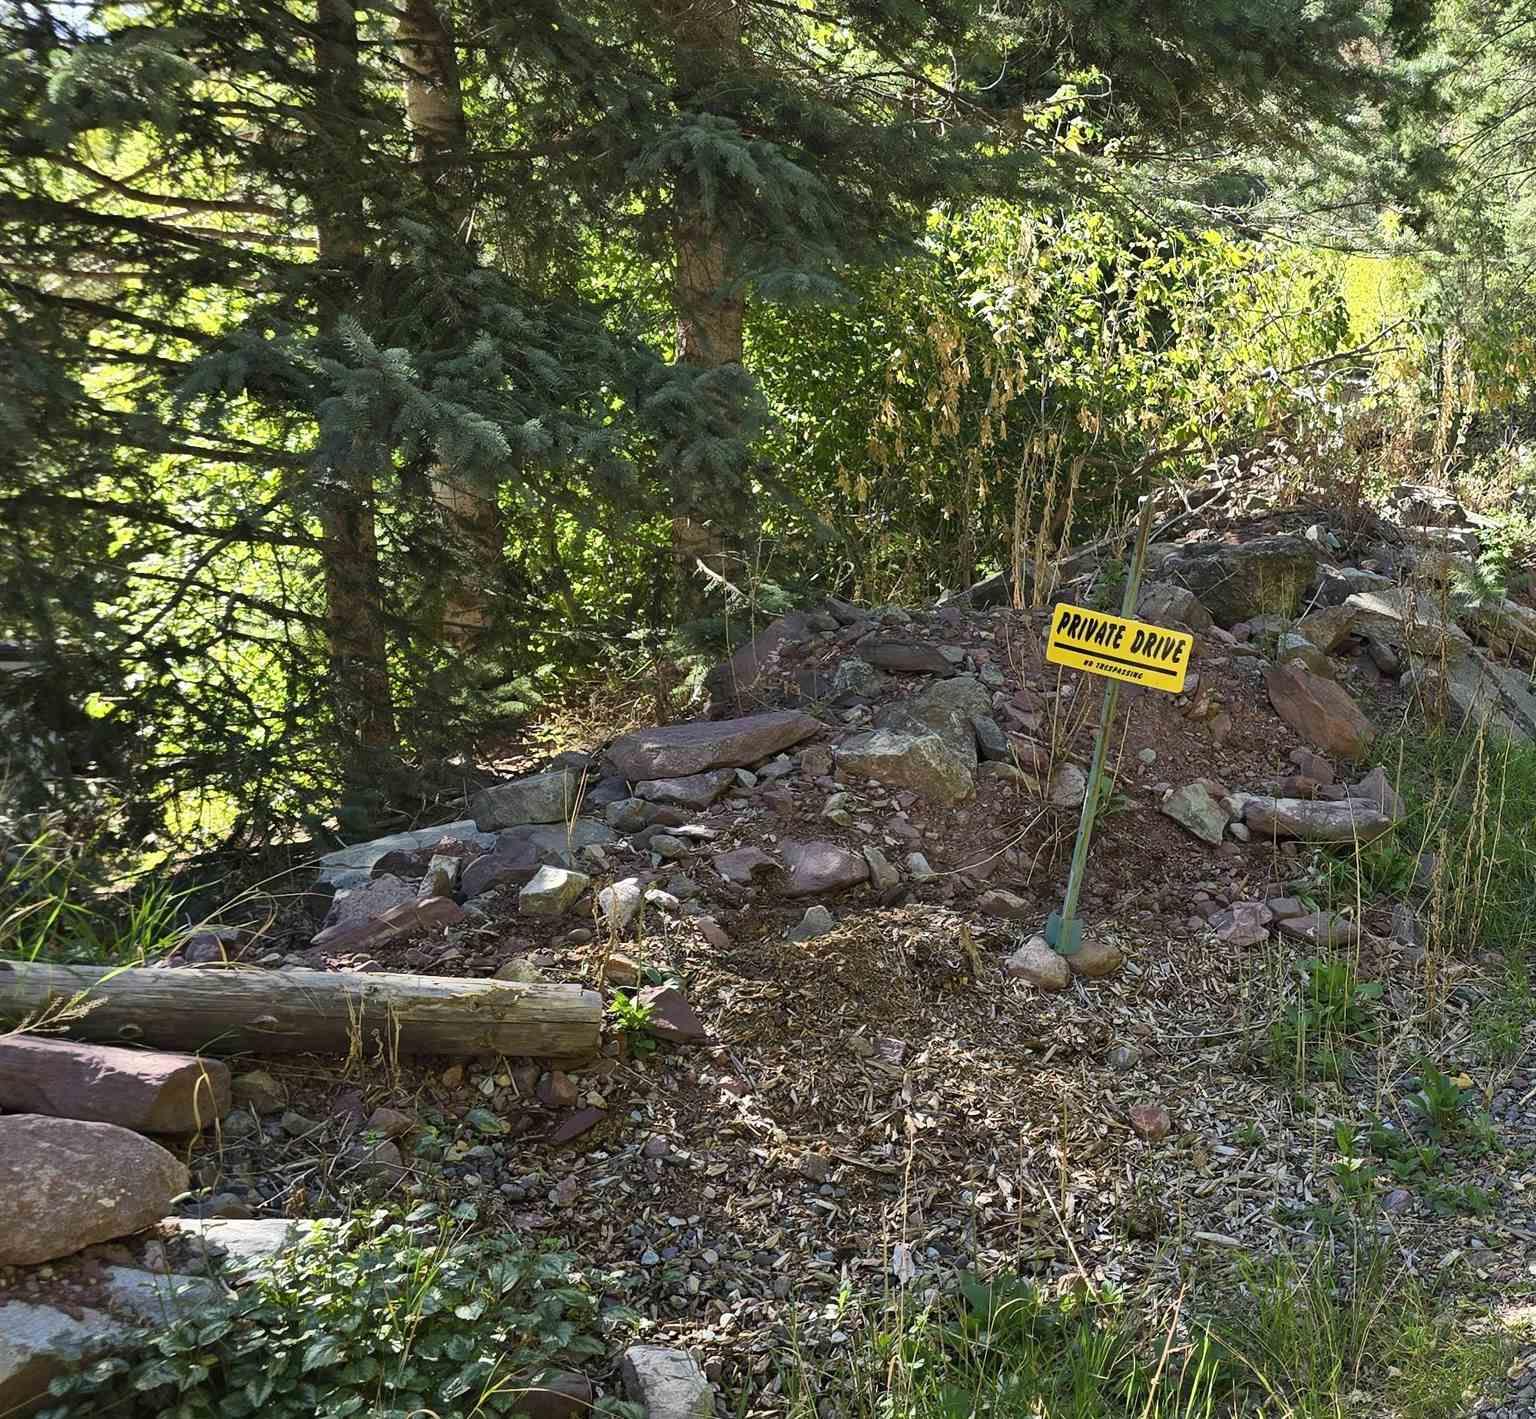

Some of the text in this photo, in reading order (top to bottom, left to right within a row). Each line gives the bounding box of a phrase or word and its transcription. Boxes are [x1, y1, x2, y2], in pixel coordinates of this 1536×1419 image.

[1056, 611, 1187, 664] PRIVATE DRIVE
[1083, 659, 1144, 680] NO TRESPASSING
